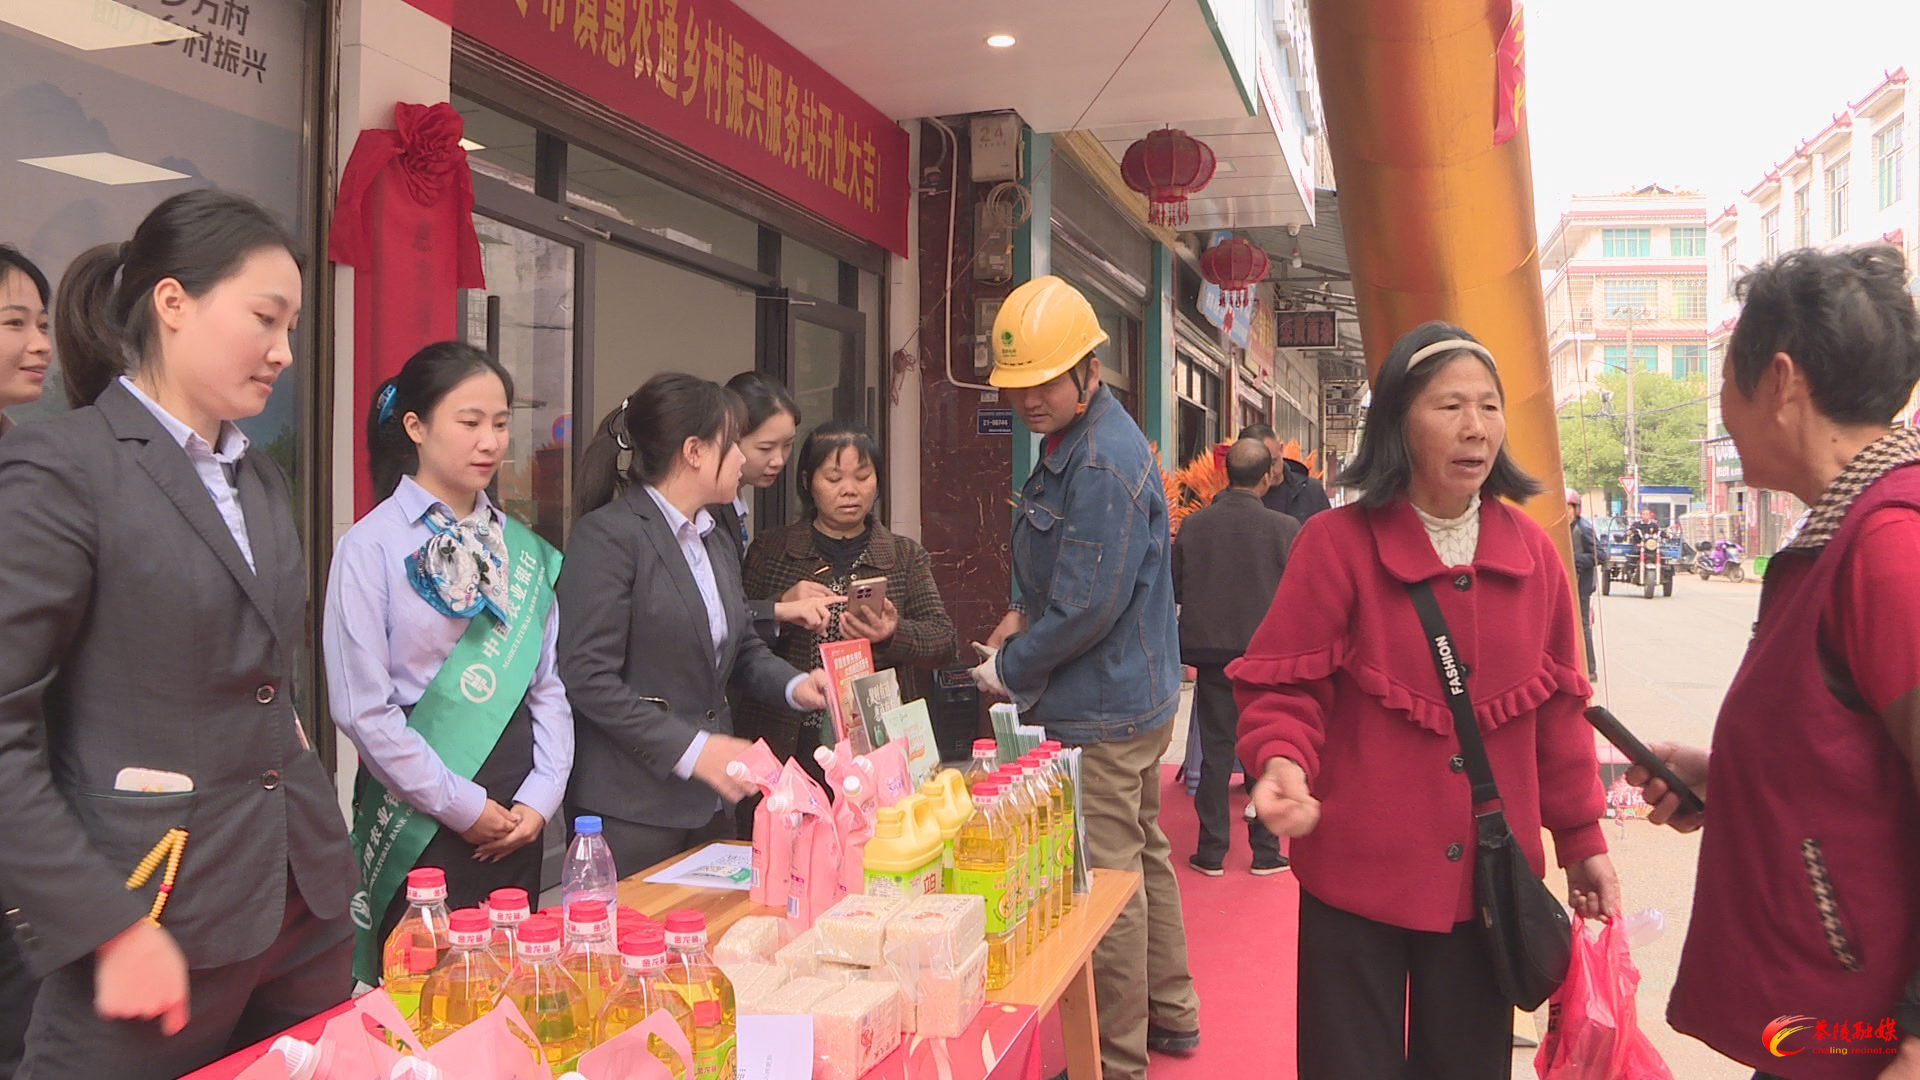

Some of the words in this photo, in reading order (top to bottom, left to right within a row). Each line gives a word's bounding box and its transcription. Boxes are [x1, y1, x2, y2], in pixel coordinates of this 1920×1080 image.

[502, 613, 532, 671] AGRICULTURAL
[1434, 635, 1465, 696] FASHION
[389, 817, 408, 841] BANK
